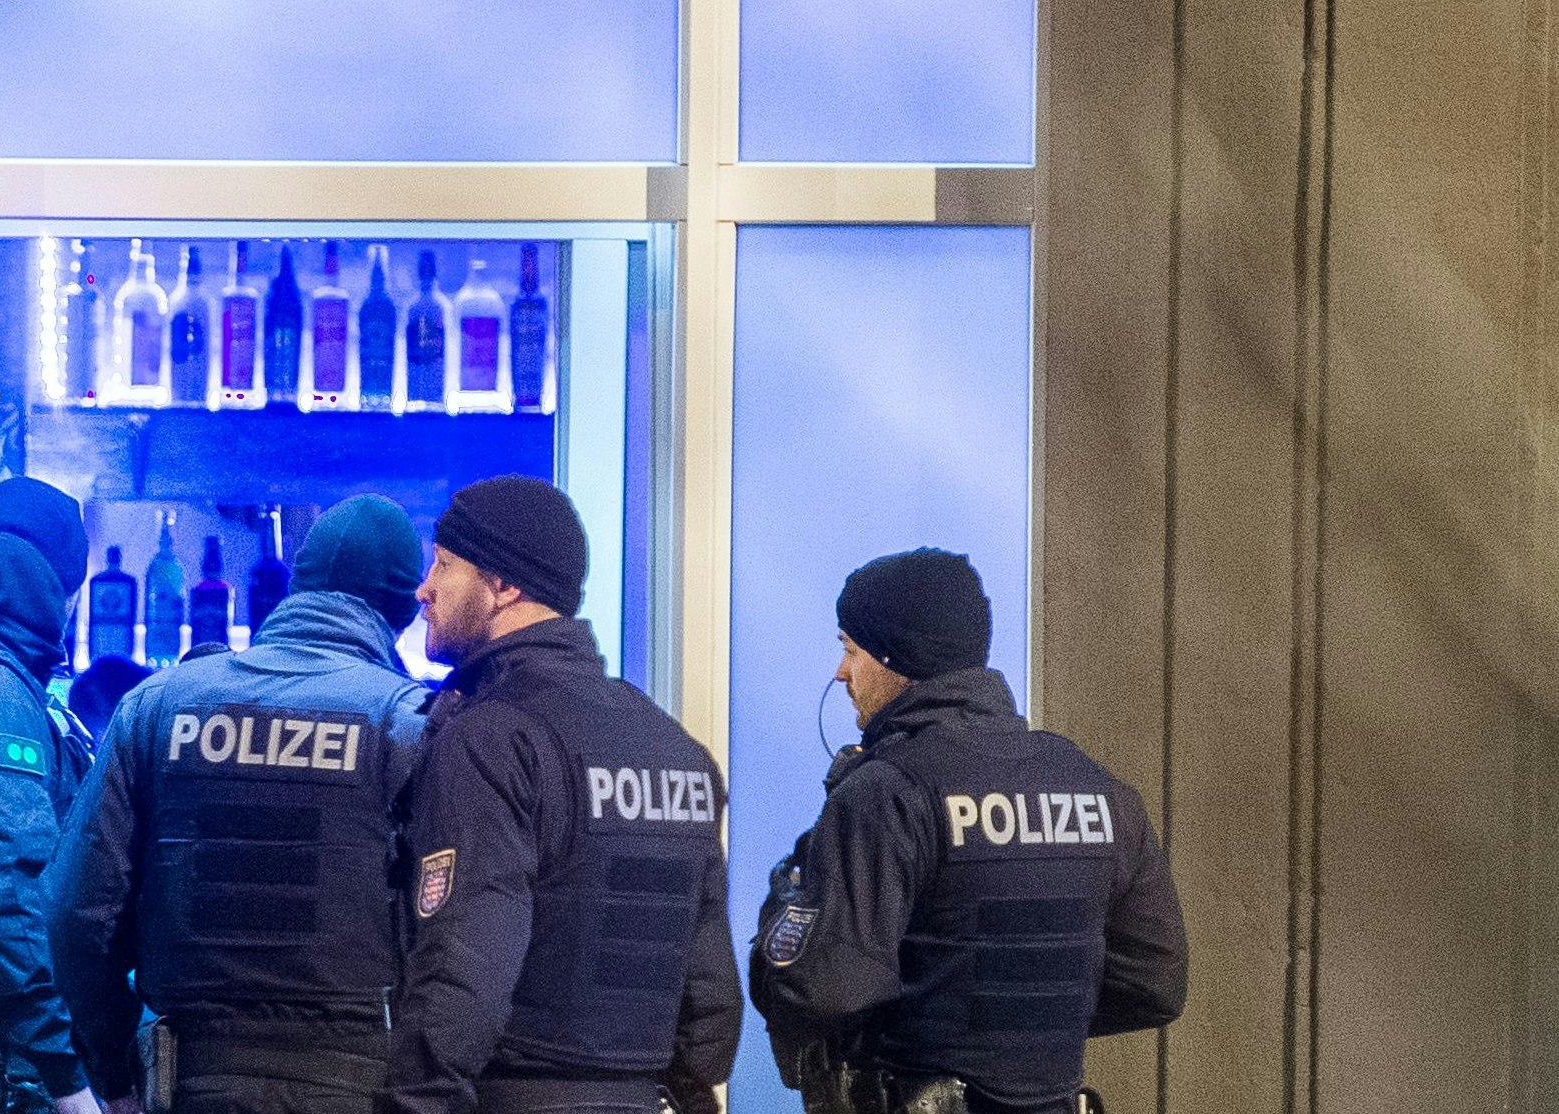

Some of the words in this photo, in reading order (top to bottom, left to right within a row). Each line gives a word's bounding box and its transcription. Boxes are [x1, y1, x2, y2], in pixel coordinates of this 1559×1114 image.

[169, 714, 360, 771] POLIZEI
[588, 767, 715, 822] POLIZEI
[946, 793, 1114, 846] POLIZEI
